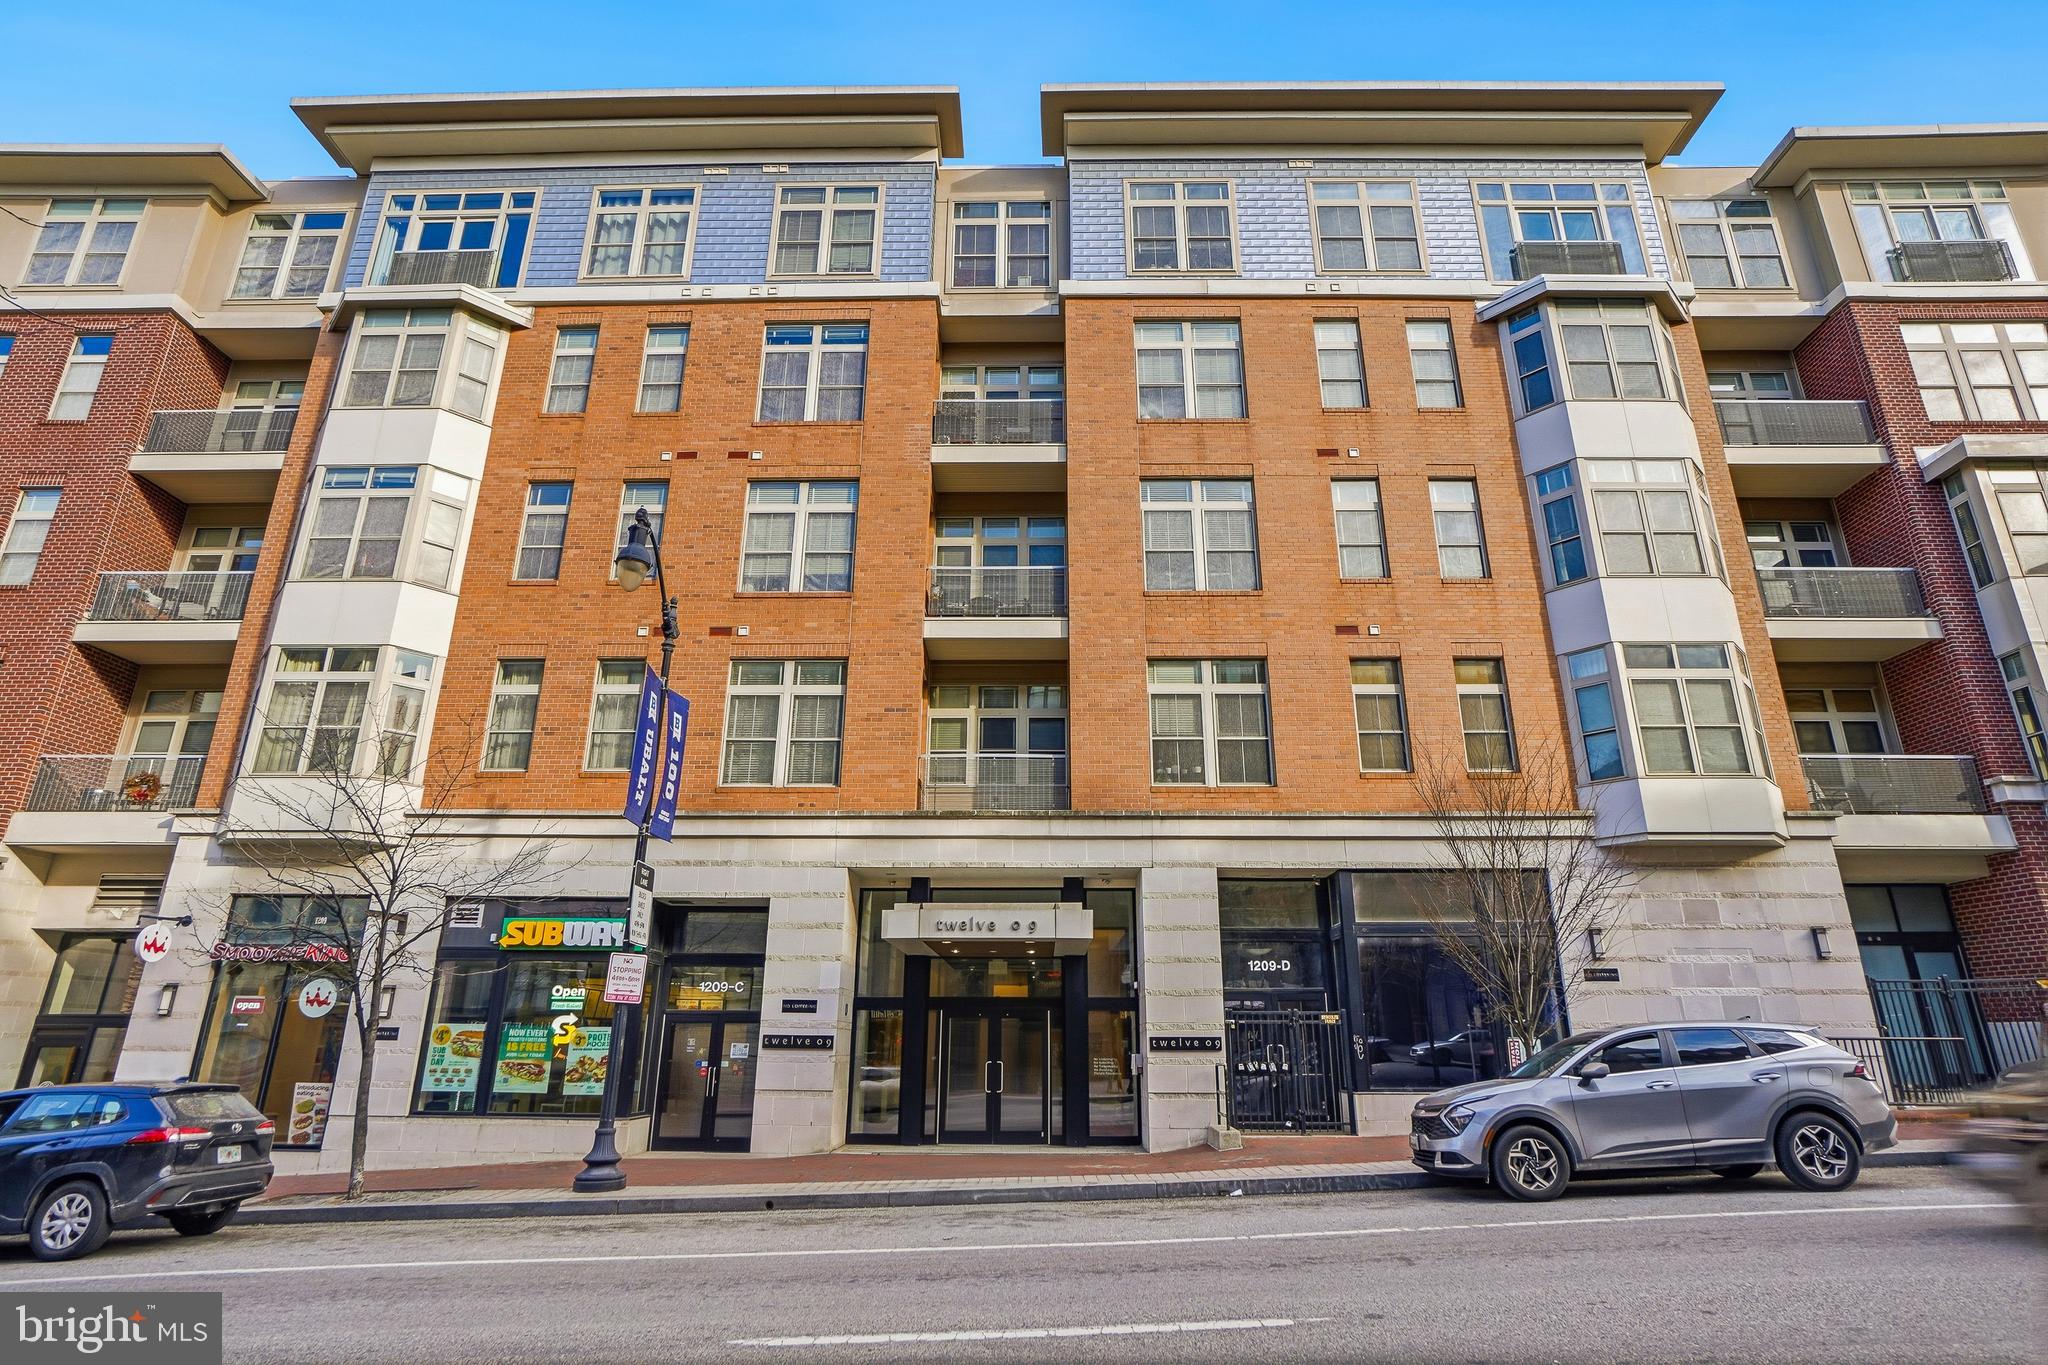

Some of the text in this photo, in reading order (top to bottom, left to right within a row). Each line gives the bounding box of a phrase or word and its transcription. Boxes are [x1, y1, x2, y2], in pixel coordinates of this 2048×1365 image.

[635, 728, 654, 806] UBALT
[665, 748, 680, 801] 100
[936, 917, 996, 932] twelve
[499, 921, 626, 948] SUBWAY
[1247, 960, 1291, 971] 1209-D
[551, 985, 586, 999] Open
[699, 981, 744, 993] 1209-C
[237, 1001, 260, 1010] open
[508, 1028, 548, 1037] NOW EVERY
[764, 1035, 811, 1045] twelve
[1152, 1037, 1200, 1047] twelve
[519, 1042, 547, 1051] FREE
